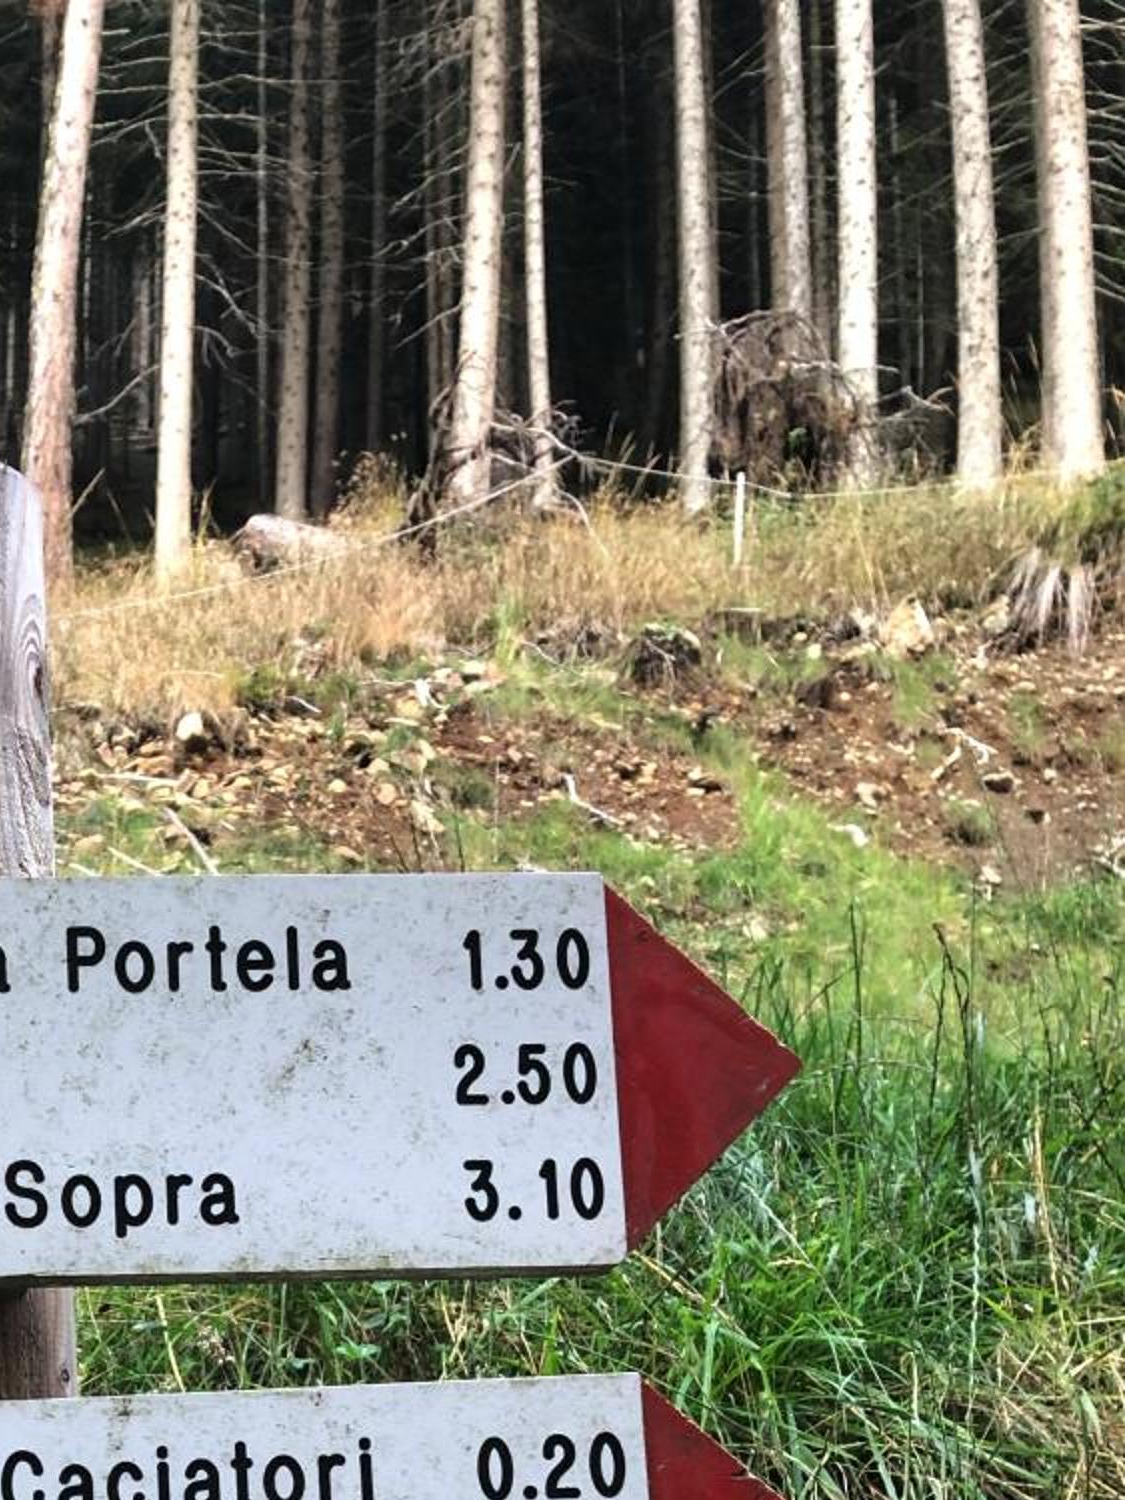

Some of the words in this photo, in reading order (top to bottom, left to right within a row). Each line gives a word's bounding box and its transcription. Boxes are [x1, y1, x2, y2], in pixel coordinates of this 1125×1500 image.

[66, 925, 352, 994] Portela
[462, 927, 590, 991] 1.30
[454, 1042, 597, 1106] 2.50
[4, 1159, 240, 1239] Sopra
[463, 1157, 604, 1222] 3.10
